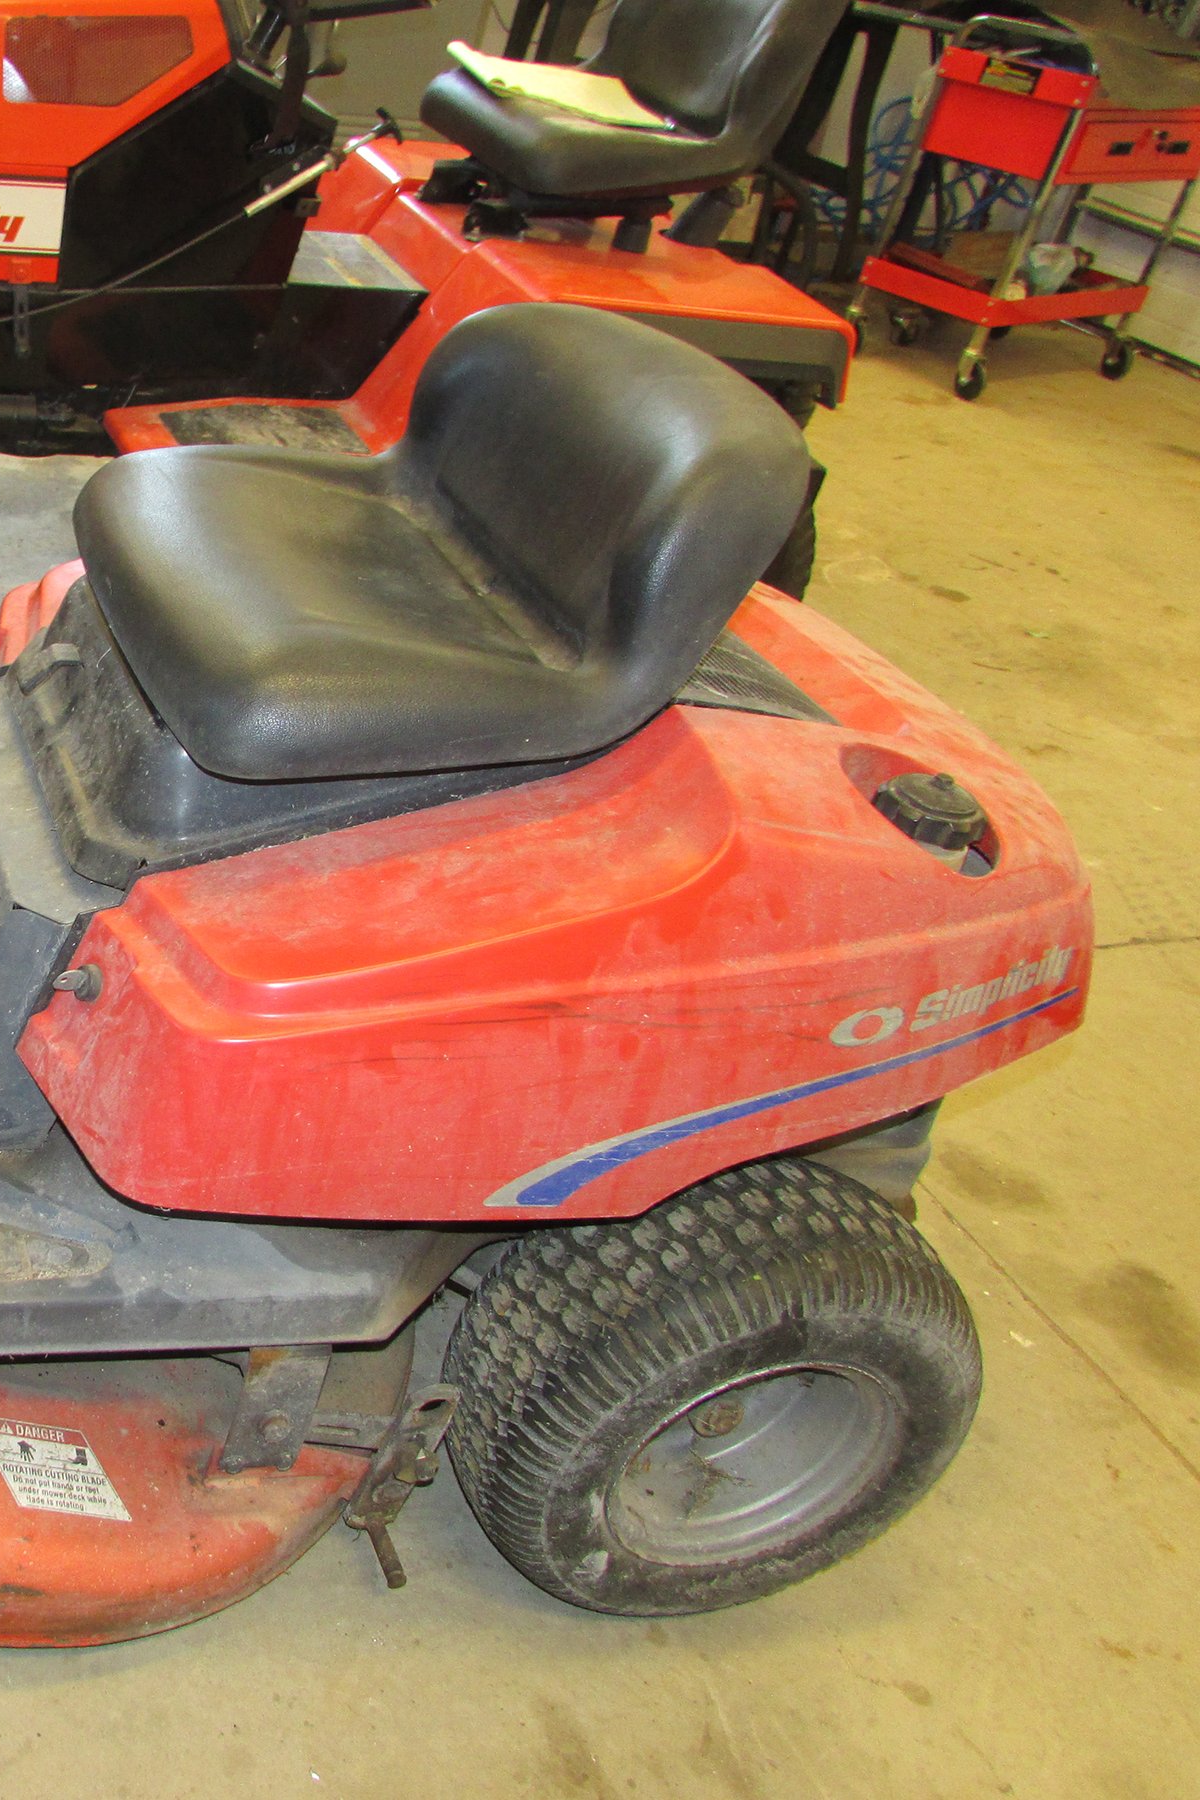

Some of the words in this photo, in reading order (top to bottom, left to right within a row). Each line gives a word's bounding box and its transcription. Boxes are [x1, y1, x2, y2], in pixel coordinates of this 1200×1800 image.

[909, 944, 1073, 1032] Simplicity
[16, 1424, 65, 1443] DANGER
[2, 1463, 43, 1477] ROTATING
[45, 1469, 80, 1482] CUTTING
[81, 1475, 107, 1486] BLADE
[13, 1474, 24, 1483] Do
[24, 1477, 37, 1485] not
[38, 1478, 51, 1487] put
[52, 1480, 74, 1491] hands
[18, 1485, 40, 1495] under
[41, 1488, 67, 1498] mower
[68, 1491, 86, 1501] deck
[87, 1494, 107, 1505] while
[46, 1497, 54, 1506] is
